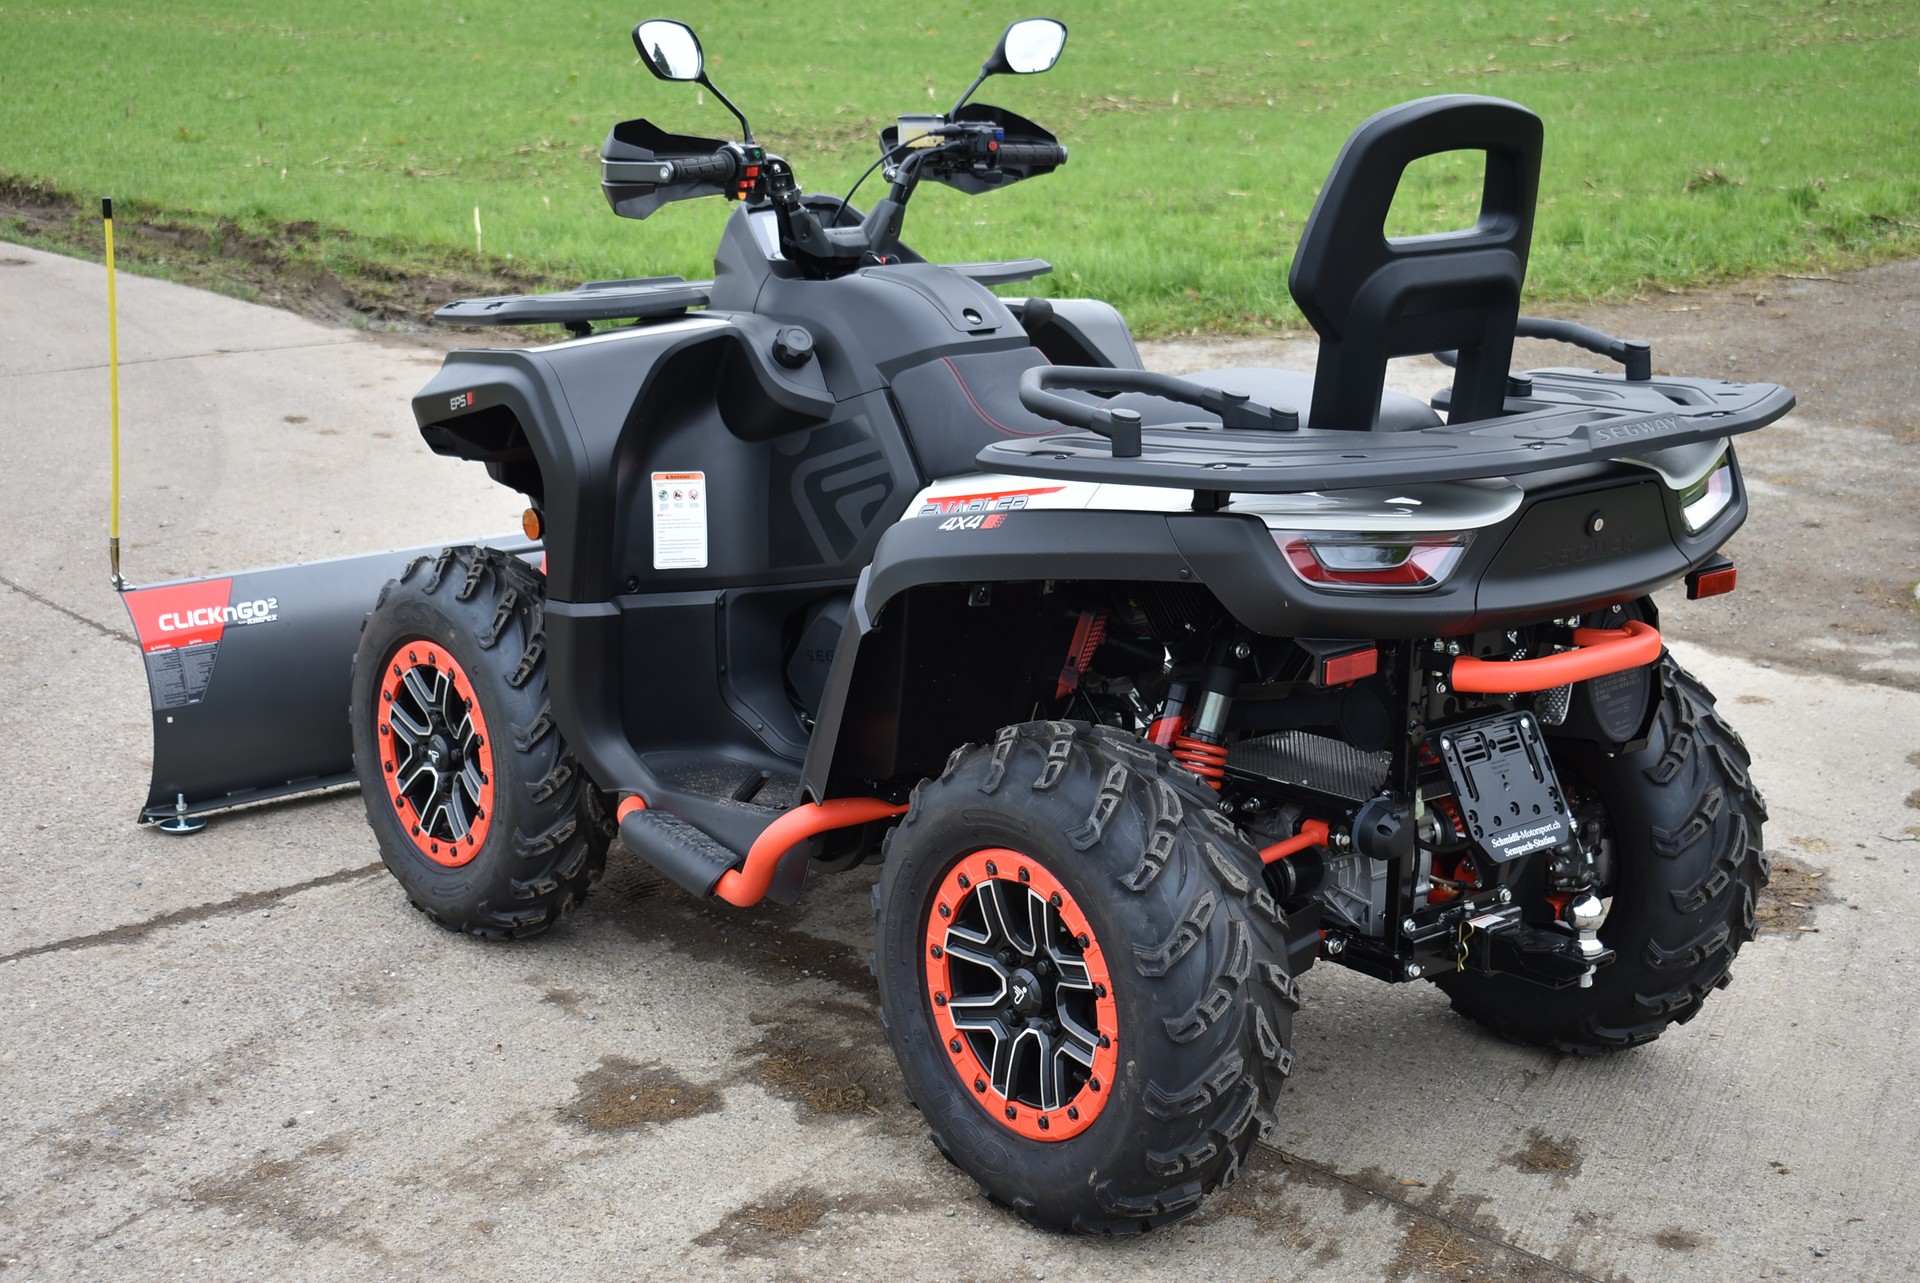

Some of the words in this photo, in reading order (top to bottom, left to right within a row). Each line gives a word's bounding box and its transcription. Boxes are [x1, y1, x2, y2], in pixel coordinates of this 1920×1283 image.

[450, 394, 467, 411] EPS
[1595, 416, 1677, 442] SEGWAY
[807, 649, 835, 663] SEG
[1491, 820, 1562, 848] Schmidli-Motorsport.ch
[1503, 835, 1557, 857] Sempach-Station
